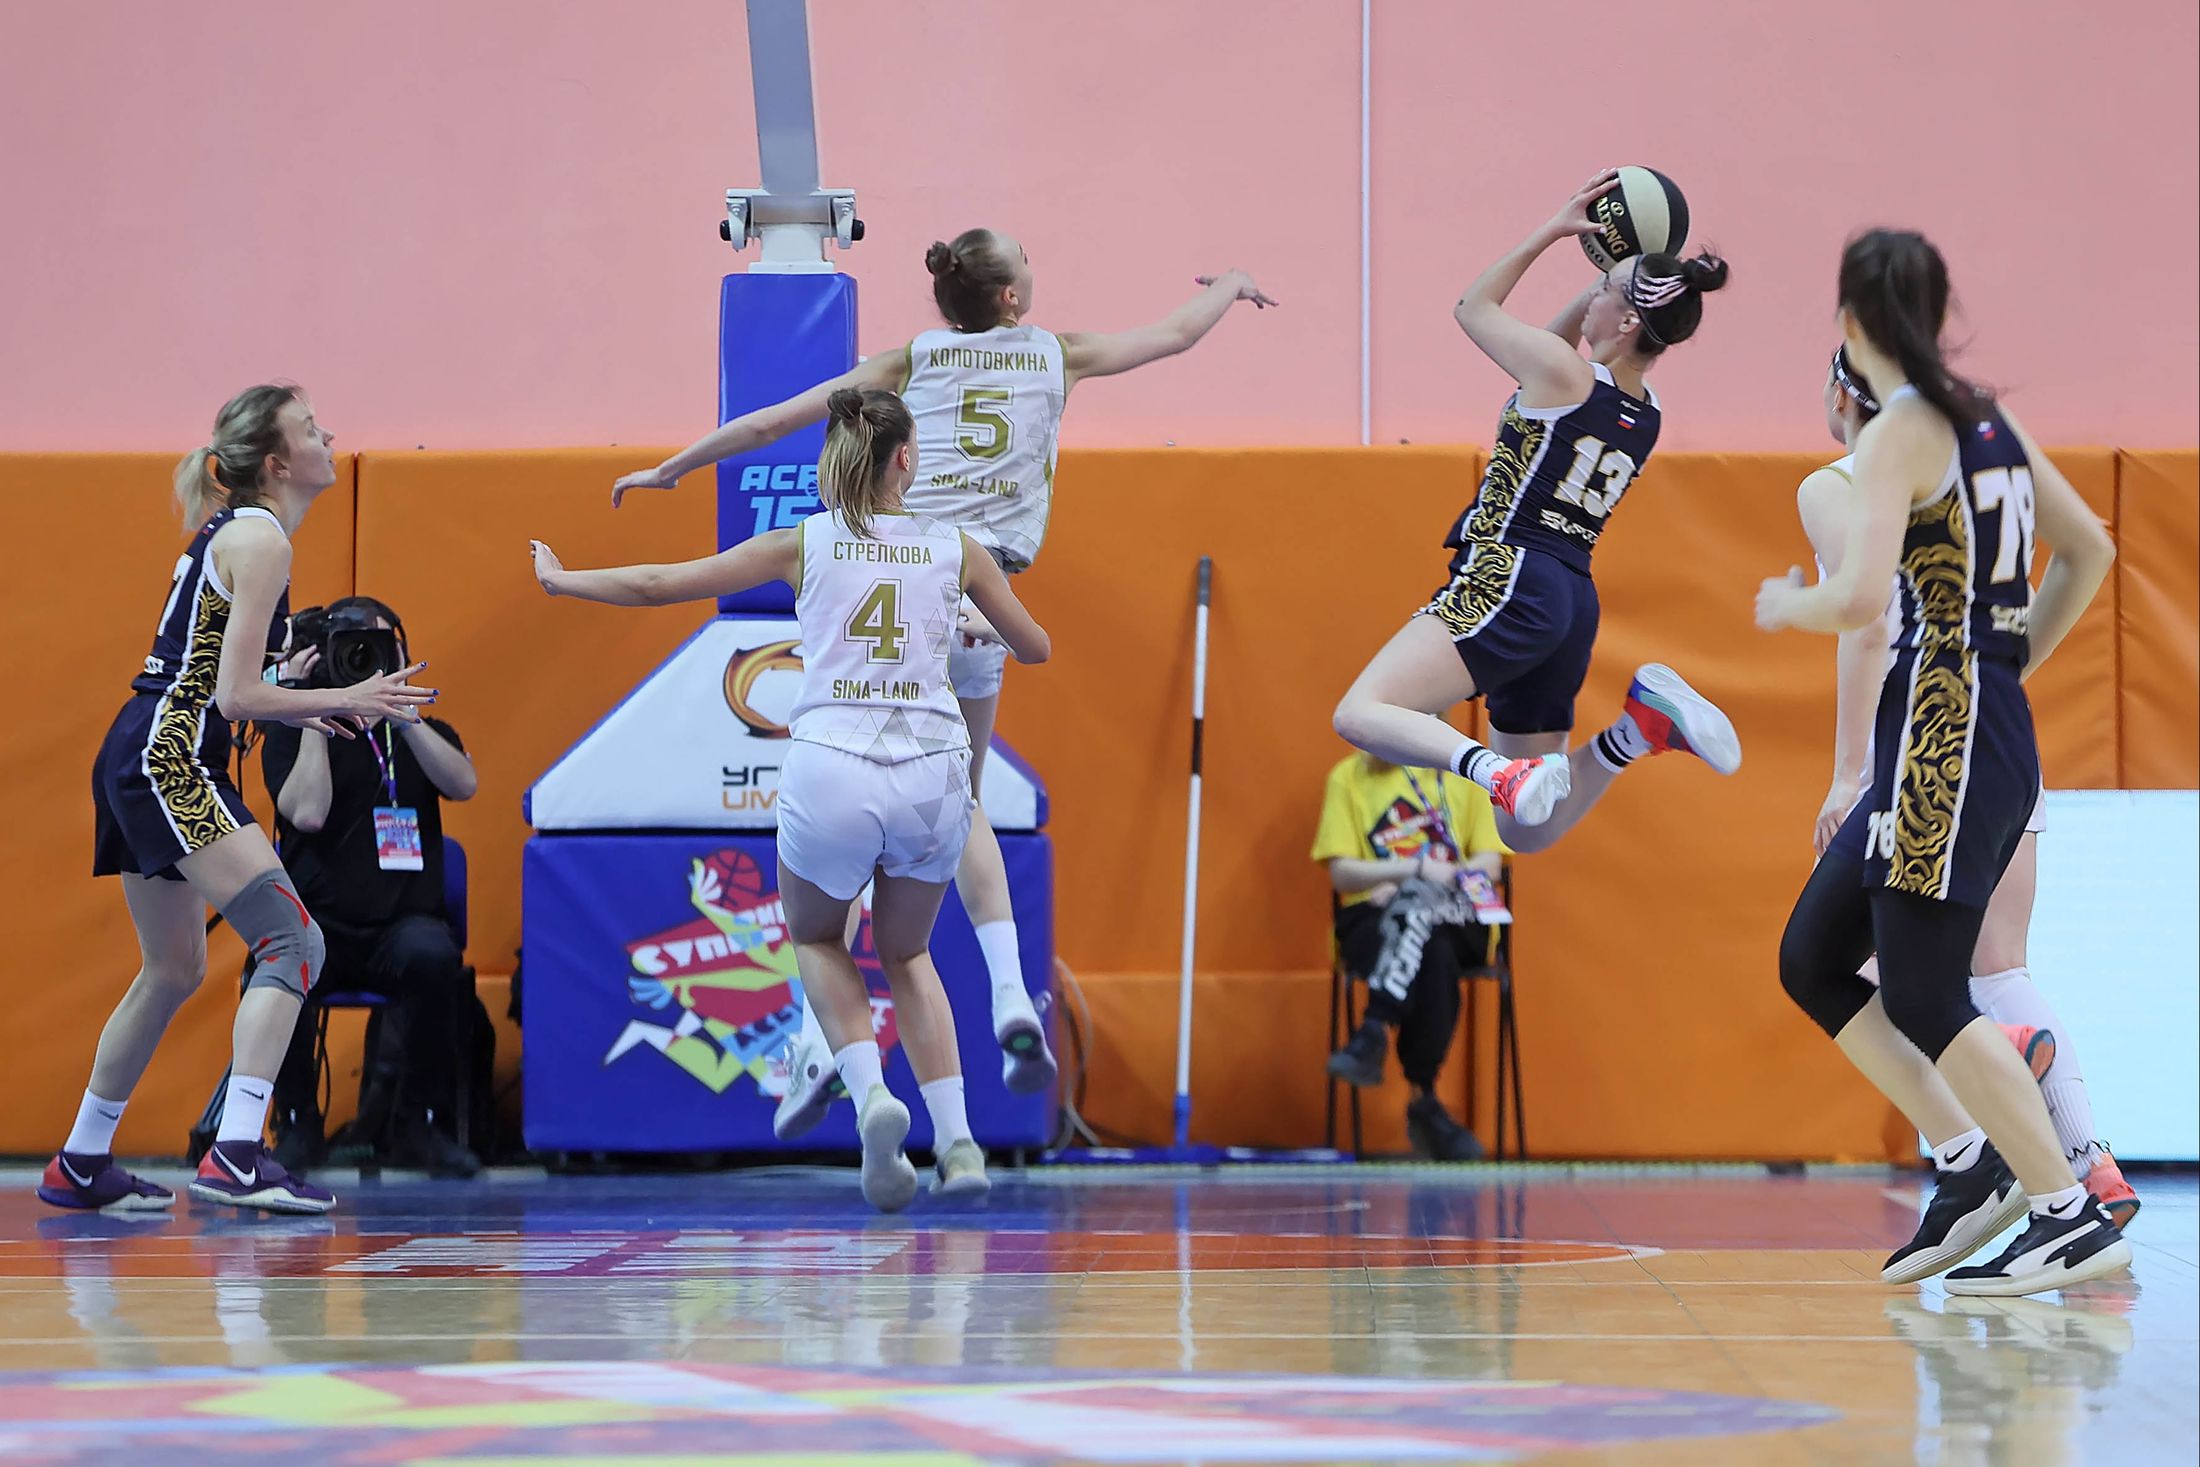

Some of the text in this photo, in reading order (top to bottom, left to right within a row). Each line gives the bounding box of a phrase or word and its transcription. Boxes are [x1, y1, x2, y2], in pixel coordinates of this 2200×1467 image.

[1595, 194, 1630, 255] ALDING
[929, 347, 1049, 373] КОЛОТОВКИНА
[953, 383, 1015, 464] 5
[931, 474, 1019, 498] SIMA-LAND
[1553, 434, 1638, 519] 13
[833, 541, 933, 565] СТРЕЛКОВА
[844, 577, 910, 665] 4
[832, 679, 920, 701] SIMA-LAND
[722, 765, 779, 786] УГ
[722, 790, 778, 810] UM
